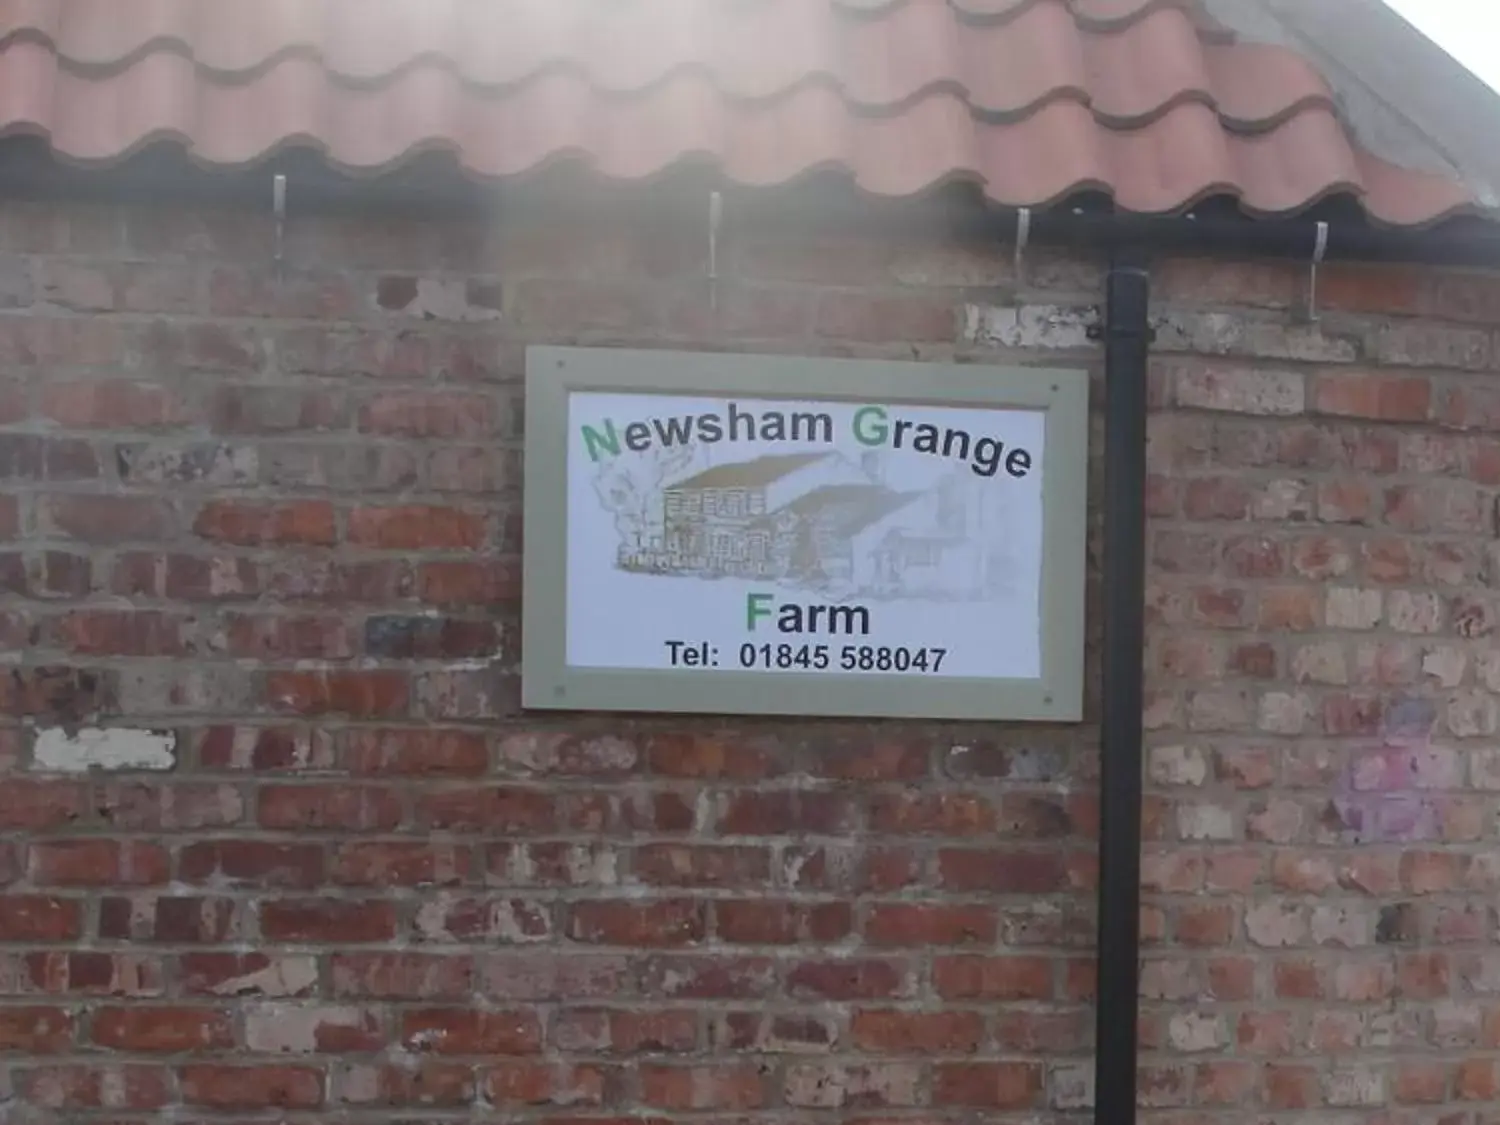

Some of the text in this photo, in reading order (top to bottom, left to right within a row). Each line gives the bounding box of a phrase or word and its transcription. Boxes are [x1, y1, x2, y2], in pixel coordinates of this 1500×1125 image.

[581, 403, 1033, 478] Newsham Grange
[747, 593, 870, 634] Farm
[666, 641, 946, 672] Tel: 01845 588047
